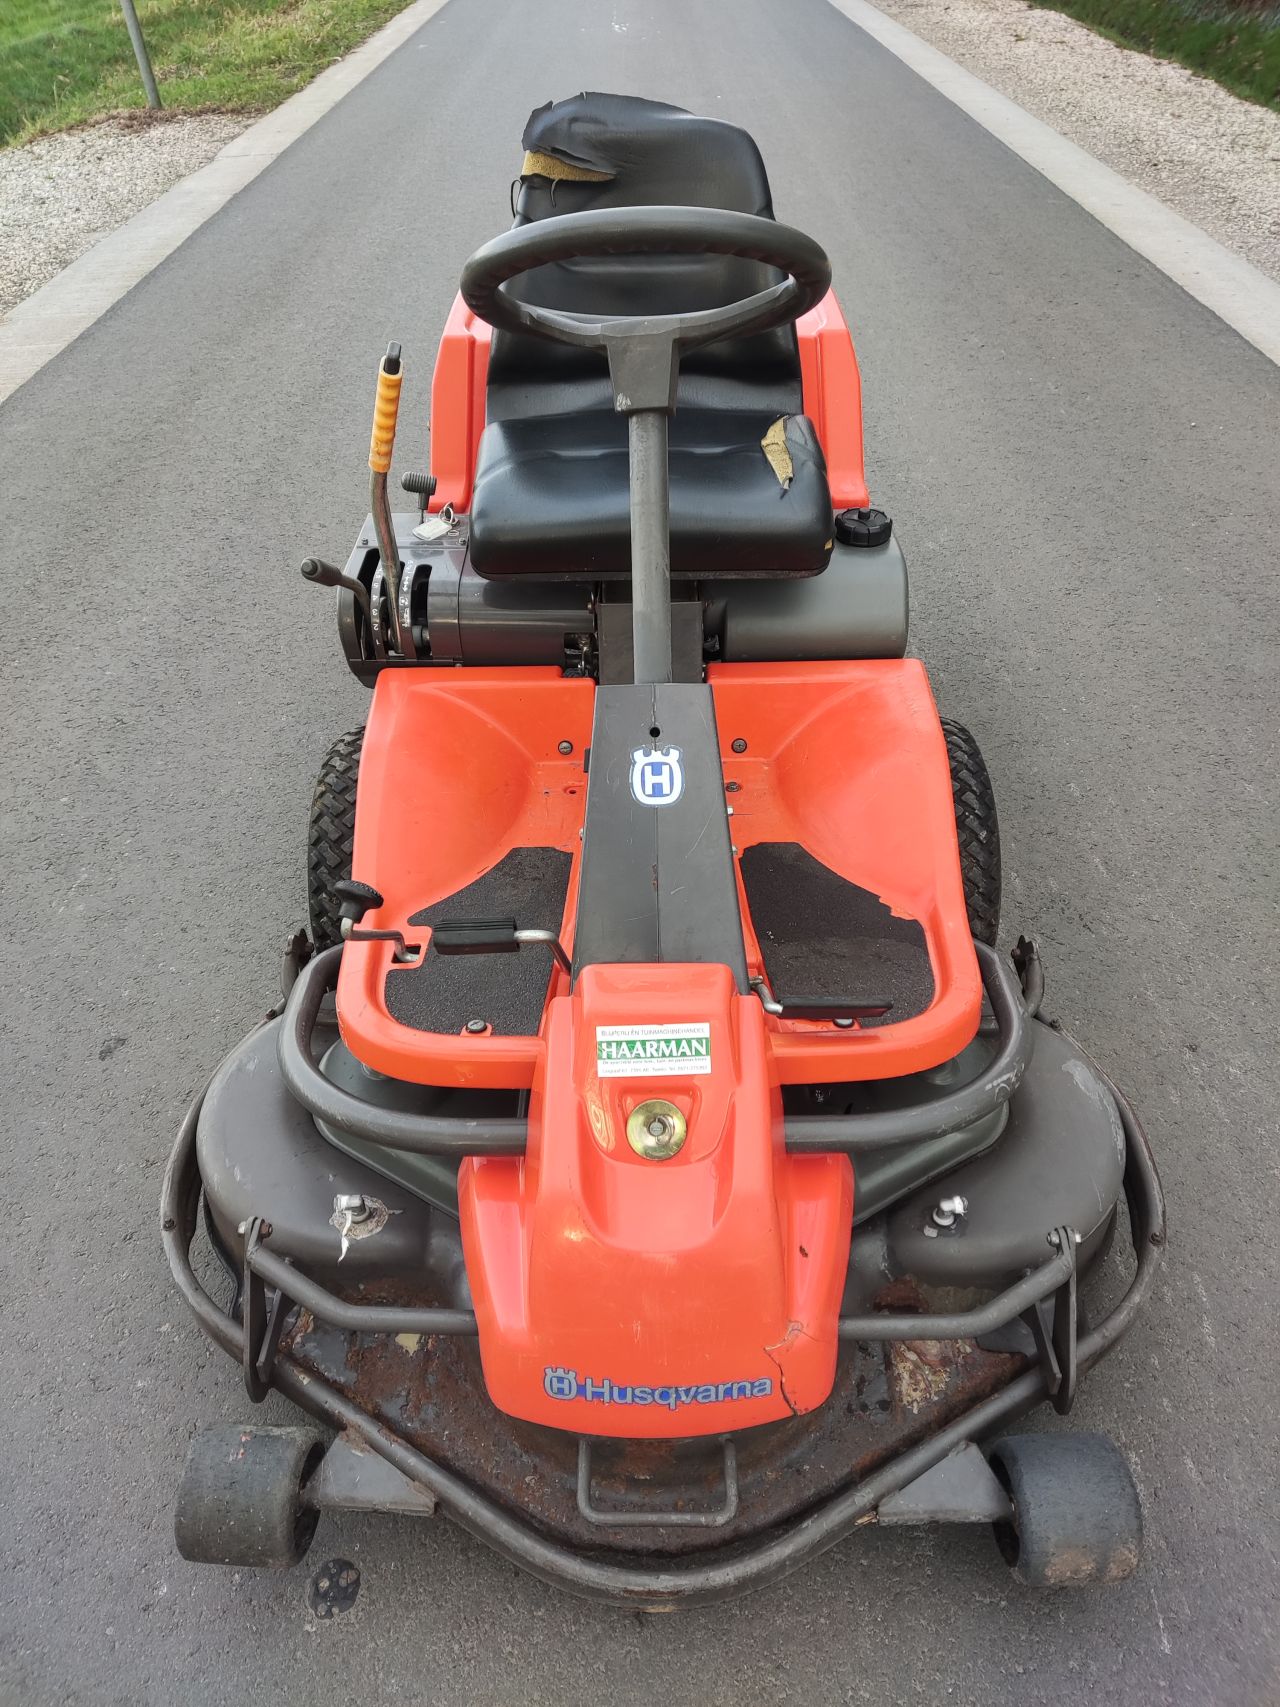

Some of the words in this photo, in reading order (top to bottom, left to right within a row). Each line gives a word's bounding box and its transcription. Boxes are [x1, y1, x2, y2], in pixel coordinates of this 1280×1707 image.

[645, 764, 671, 795] H
[601, 1038, 706, 1059] HAARMAN
[585, 1377, 772, 1410] Husqvarna
